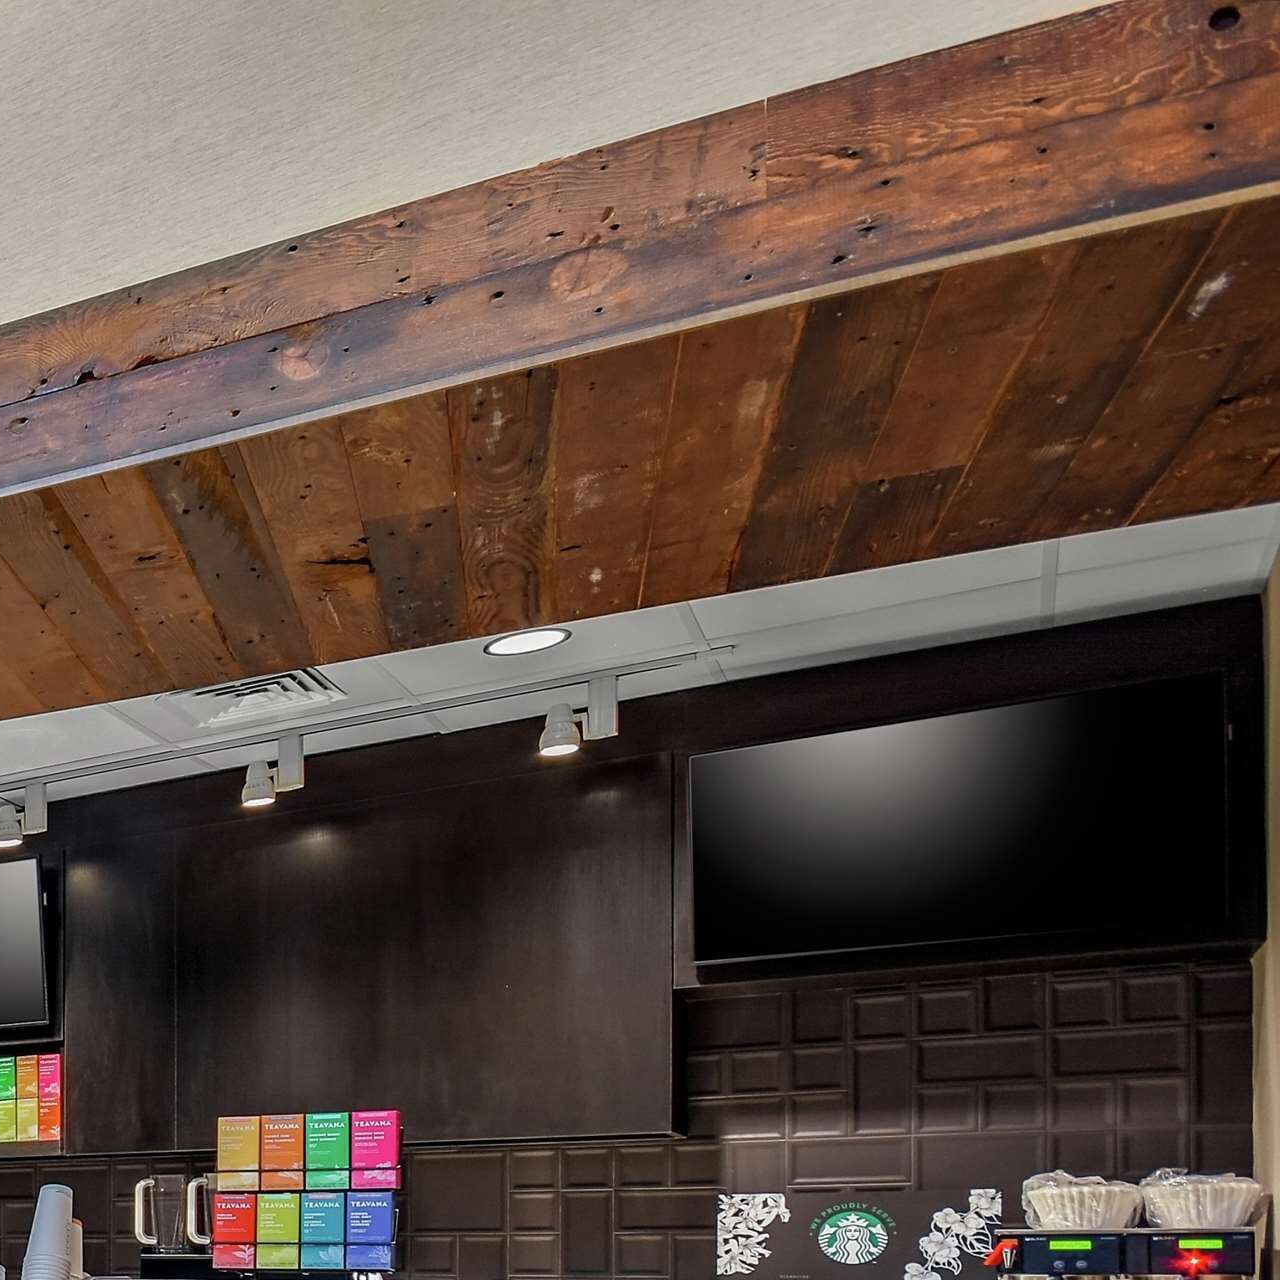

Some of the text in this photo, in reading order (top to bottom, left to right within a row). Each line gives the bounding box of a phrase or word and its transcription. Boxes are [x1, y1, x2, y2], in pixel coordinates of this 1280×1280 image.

[309, 1121, 345, 1129] TEAVANA
[809, 1202, 897, 1230] WE PROUDLY SERVE
